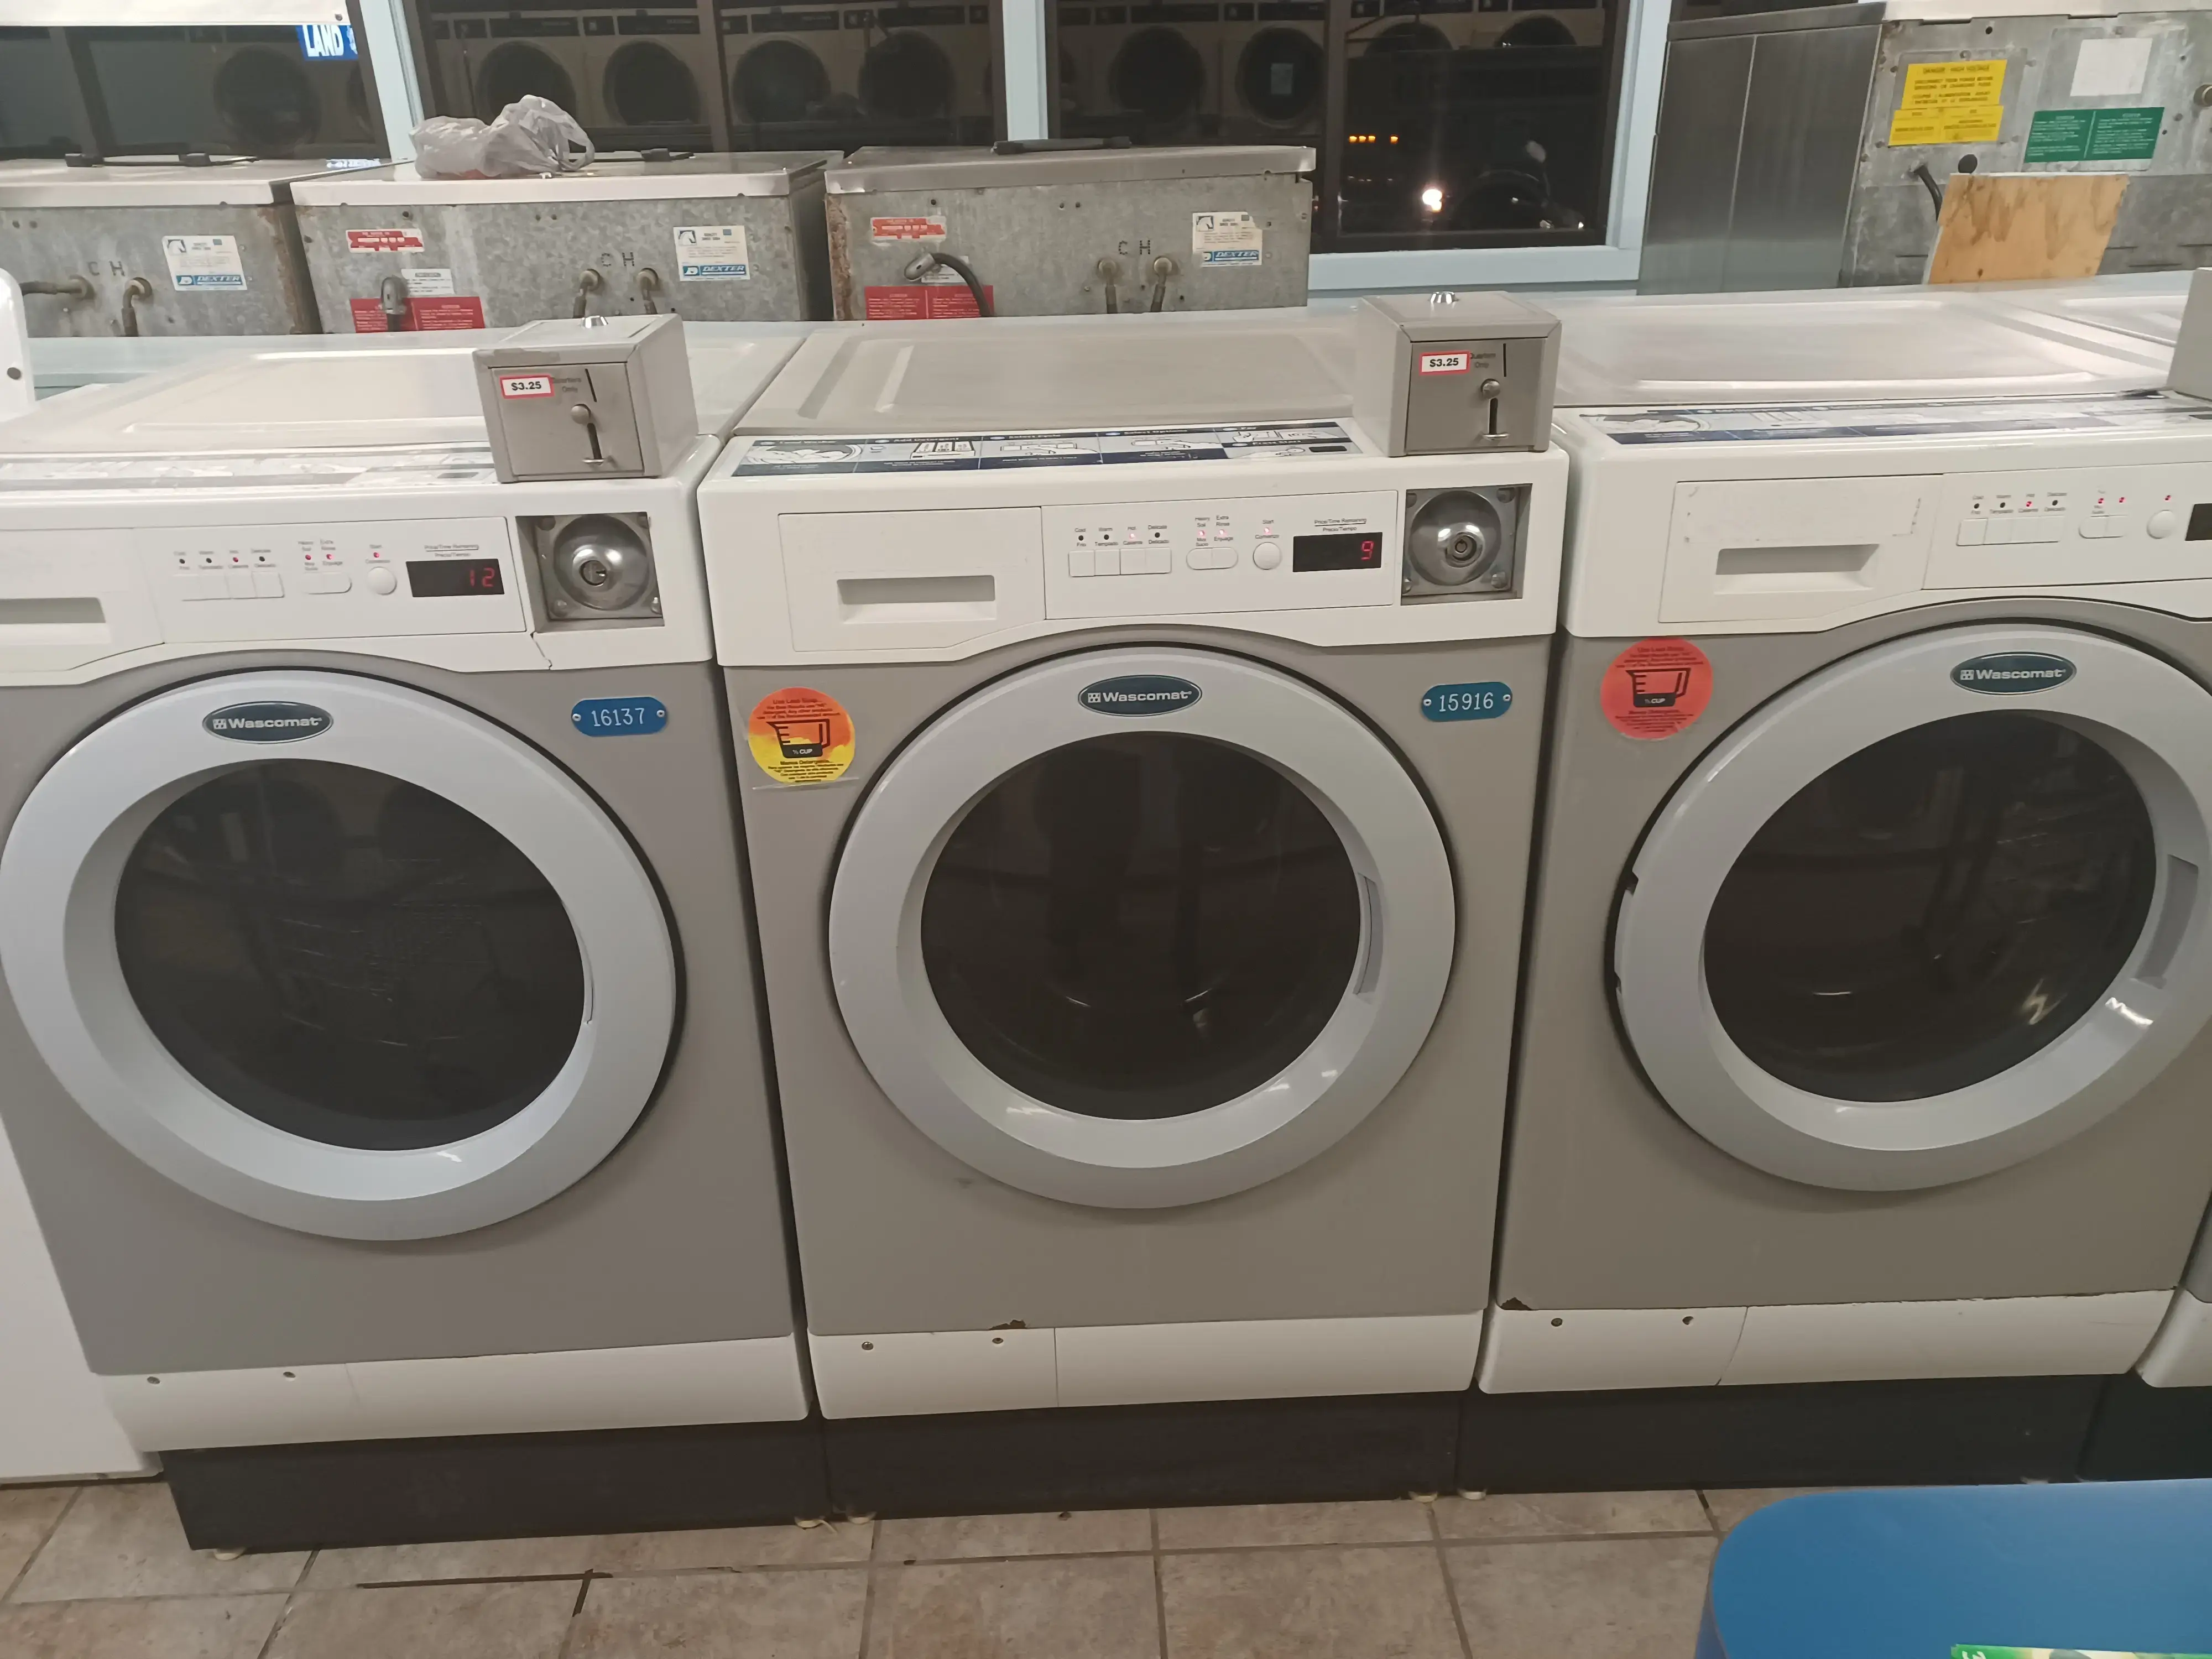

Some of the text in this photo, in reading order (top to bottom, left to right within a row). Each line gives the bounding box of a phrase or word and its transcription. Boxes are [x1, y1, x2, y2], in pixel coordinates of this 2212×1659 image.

[302, 25, 344, 57] LAND
[1118, 239, 1150, 255] C H
[622, 252, 635, 267] H
[87, 260, 125, 276] C H
[1429, 358, 1459, 368] $3.25
[511, 381, 542, 392] $3.25
[1360, 540, 1374, 560] 9
[470, 567, 495, 587] 12
[1976, 669, 2063, 680] Wascomat
[1103, 691, 1189, 702] Wascomat
[1439, 692, 1494, 712] 15916
[228, 717, 319, 729] Wascomat
[591, 708, 645, 727] 16137
